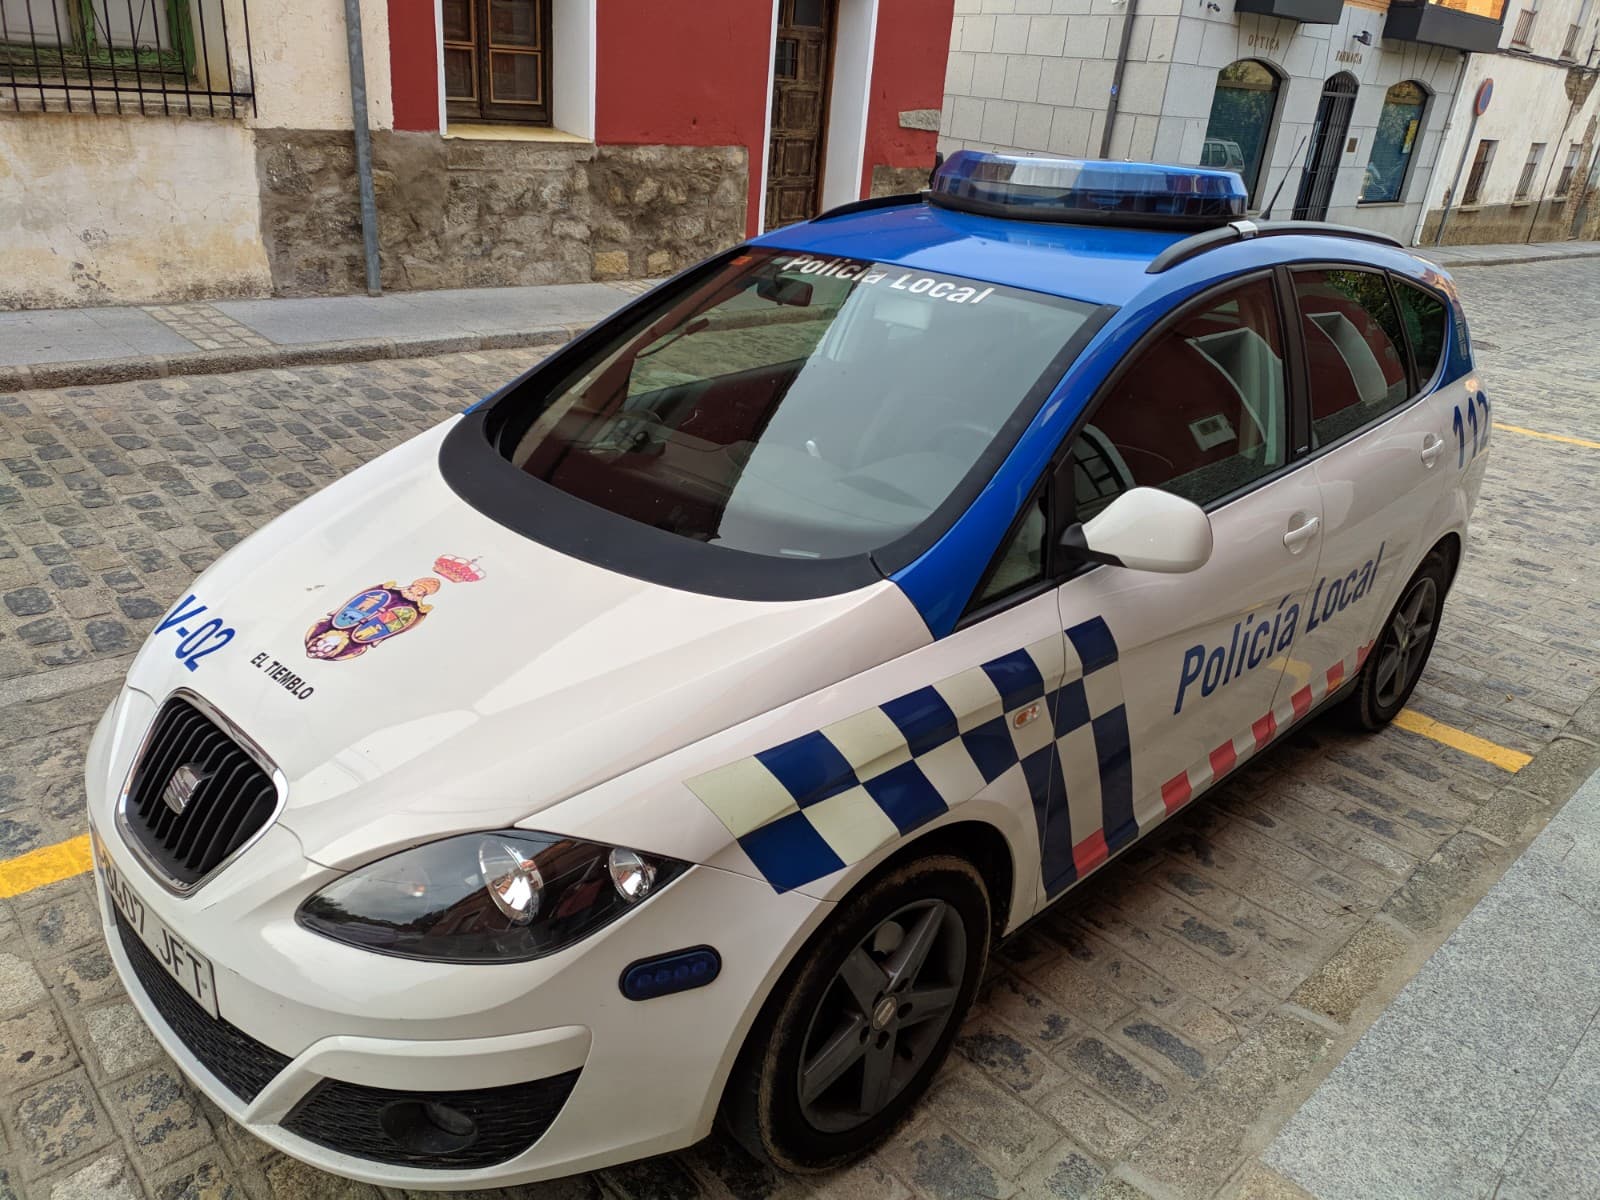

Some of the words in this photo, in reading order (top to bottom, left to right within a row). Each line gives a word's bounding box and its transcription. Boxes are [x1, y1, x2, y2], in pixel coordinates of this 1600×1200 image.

[889, 273, 995, 304] Local
[154, 594, 236, 672] V-02
[1173, 593, 1300, 716] Policía
[1305, 540, 1386, 634] Local
[250, 652, 270, 669] EL
[264, 661, 314, 700] TIEMBLO
[159, 928, 201, 998] JFT
